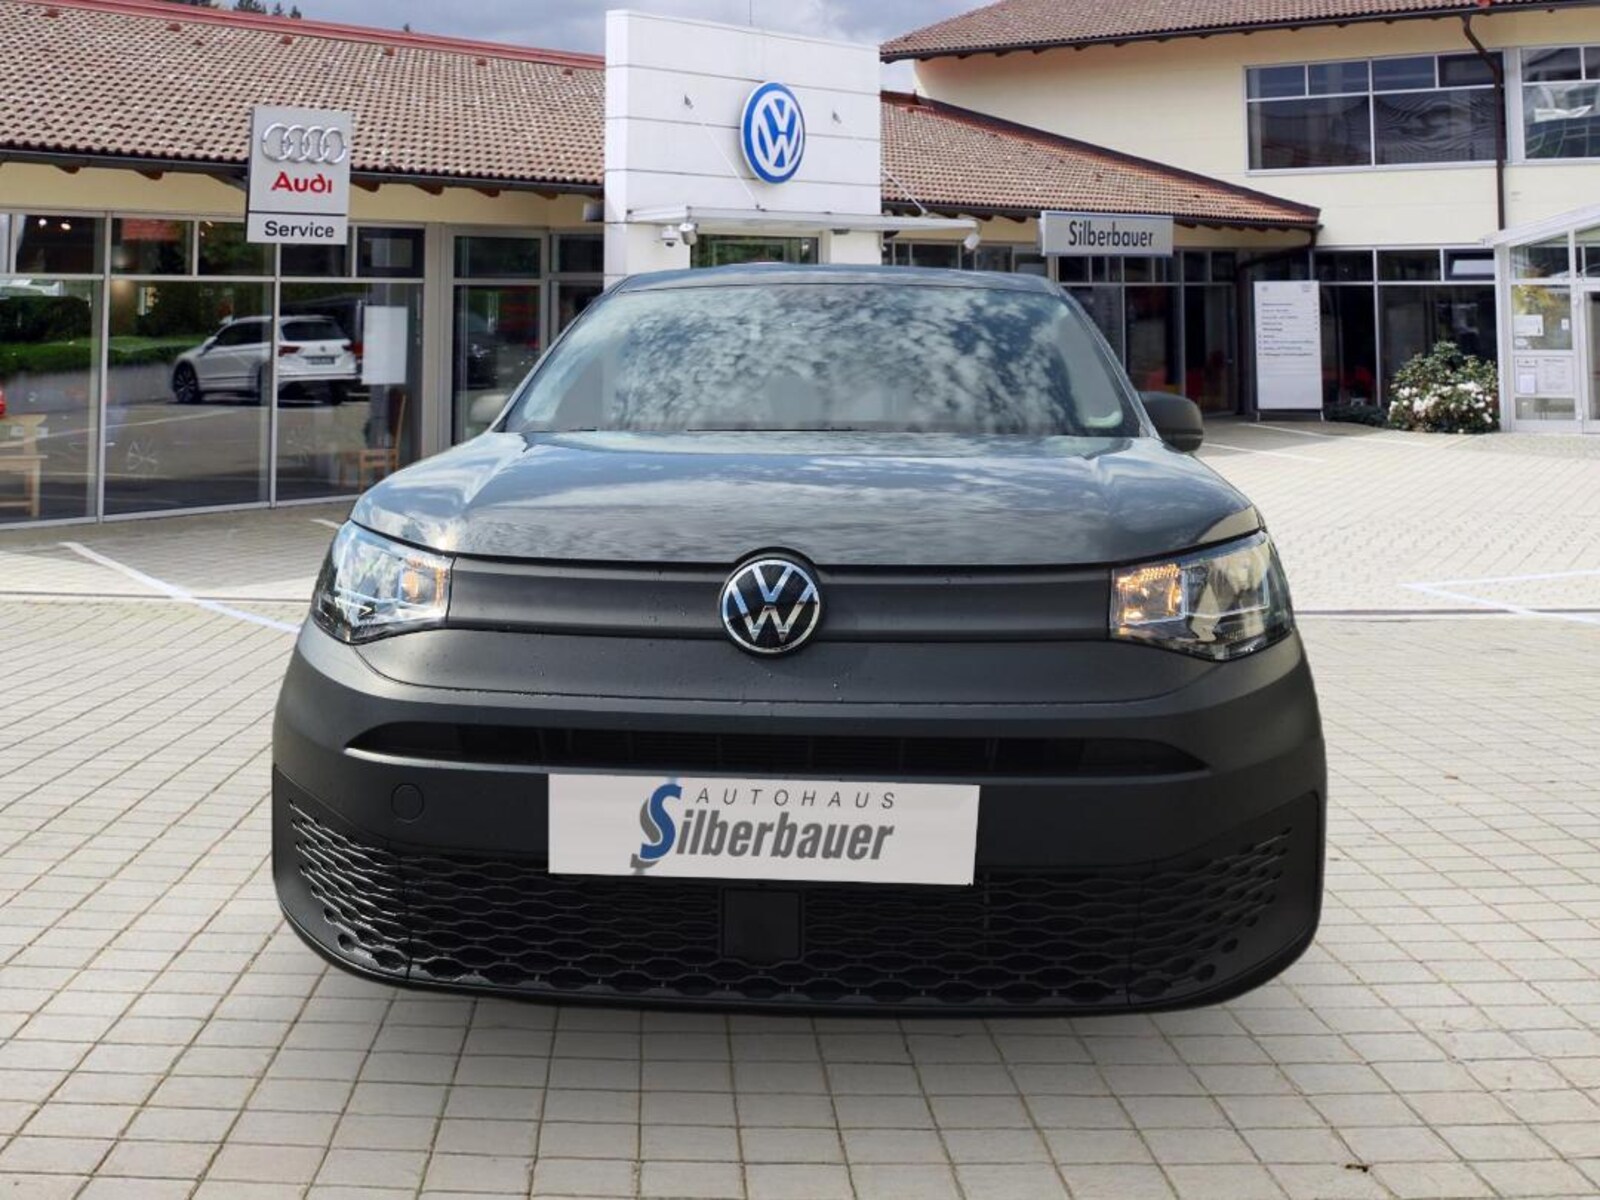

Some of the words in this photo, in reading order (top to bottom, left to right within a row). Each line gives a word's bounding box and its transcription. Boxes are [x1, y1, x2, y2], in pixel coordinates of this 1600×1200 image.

[271, 171, 333, 193] Audi
[264, 220, 335, 238] Service
[1068, 220, 1154, 247] Silberbauer
[695, 787, 896, 811] AUTOHAUS
[632, 783, 896, 864] Silberbauer
